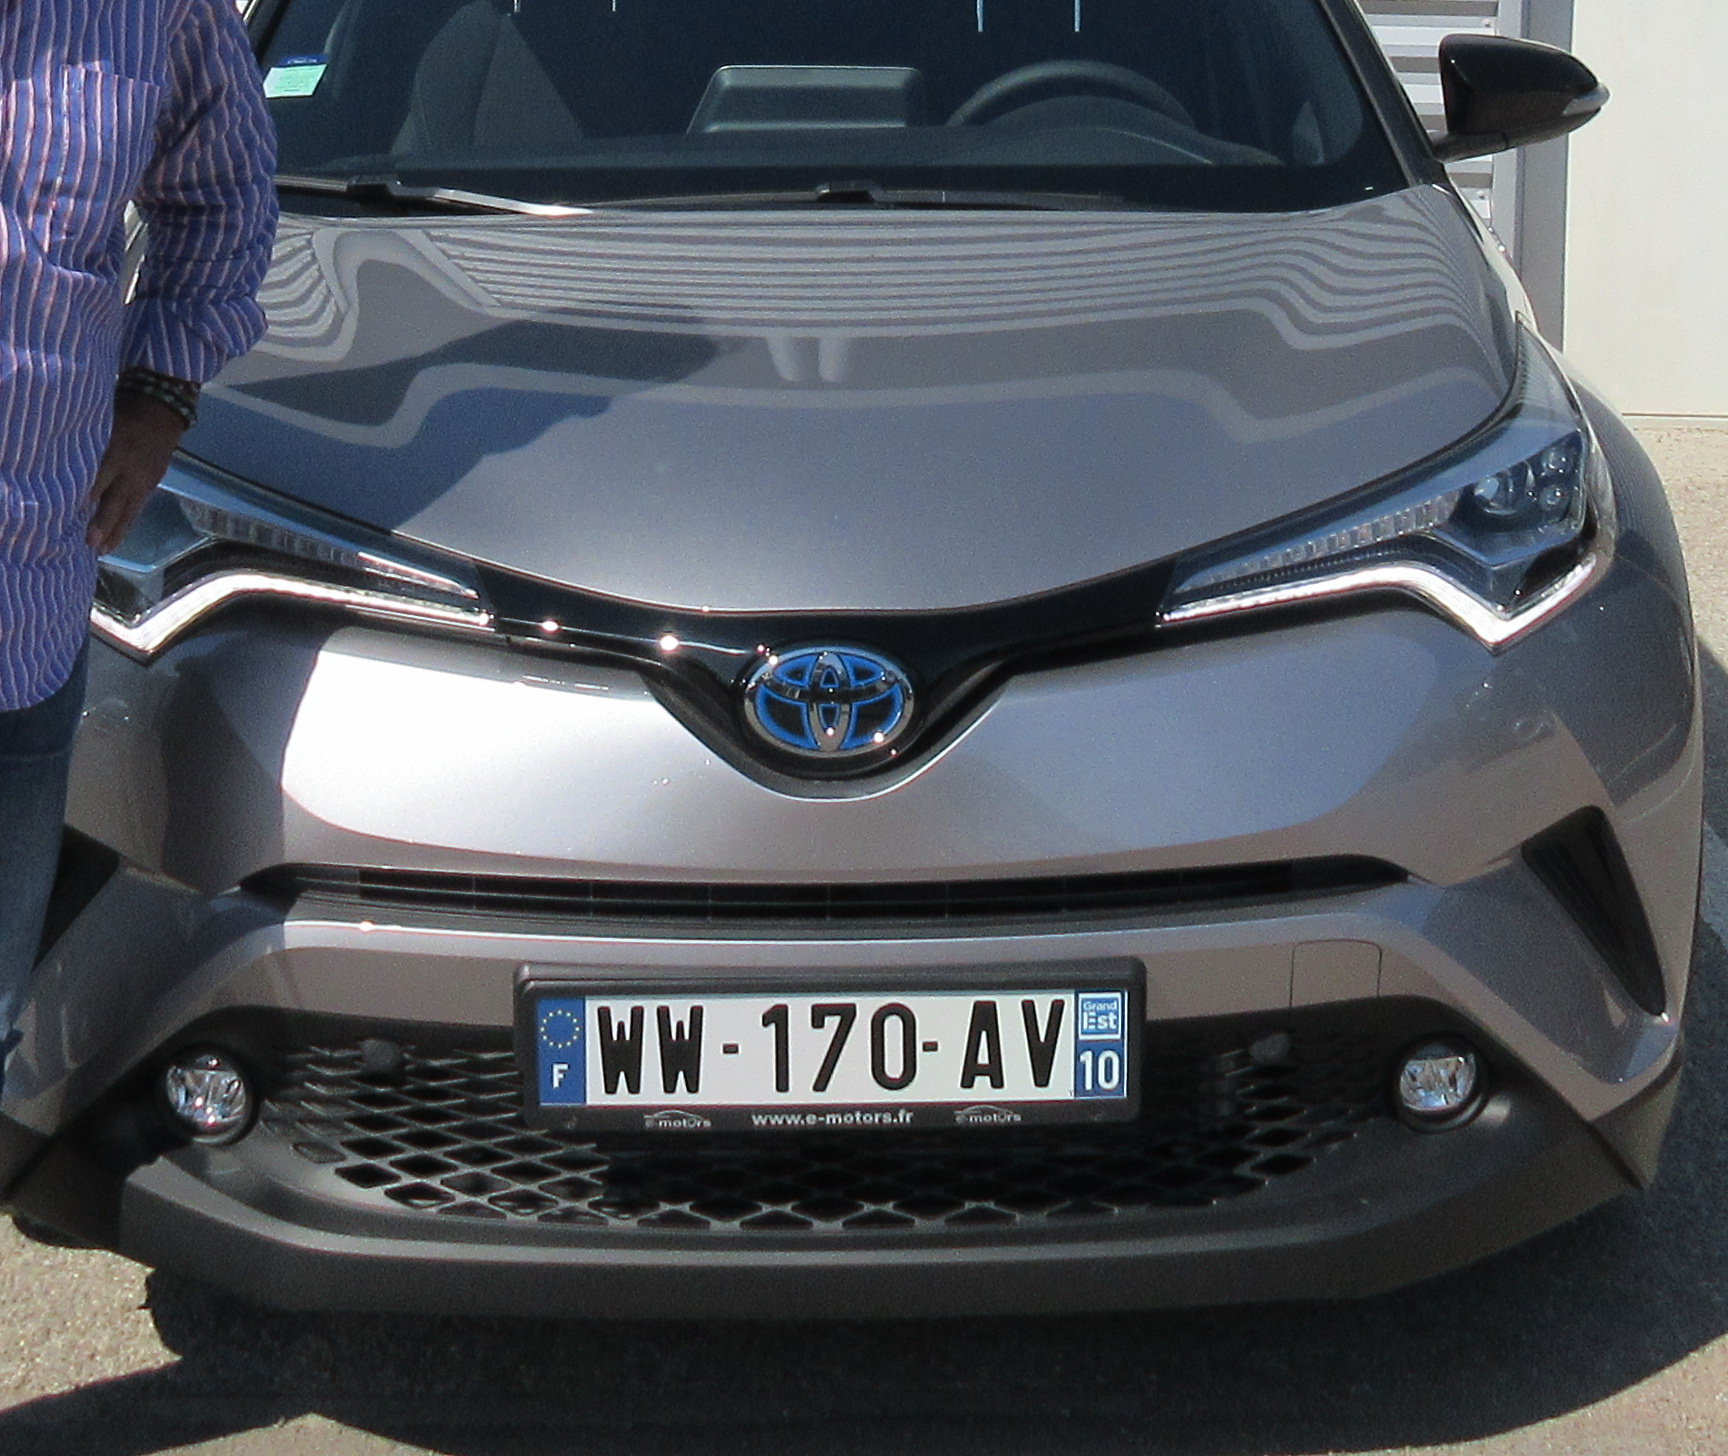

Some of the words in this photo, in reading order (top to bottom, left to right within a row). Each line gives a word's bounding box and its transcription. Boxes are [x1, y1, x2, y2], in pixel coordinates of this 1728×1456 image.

[1082, 999, 1118, 1011] Grand
[1082, 1010, 1118, 1030] Est
[596, 998, 1066, 1095] WW-170-AV
[551, 1062, 569, 1089] F
[1078, 1049, 1121, 1092] 10
[751, 1109, 914, 1127] www.e-motors.fr
